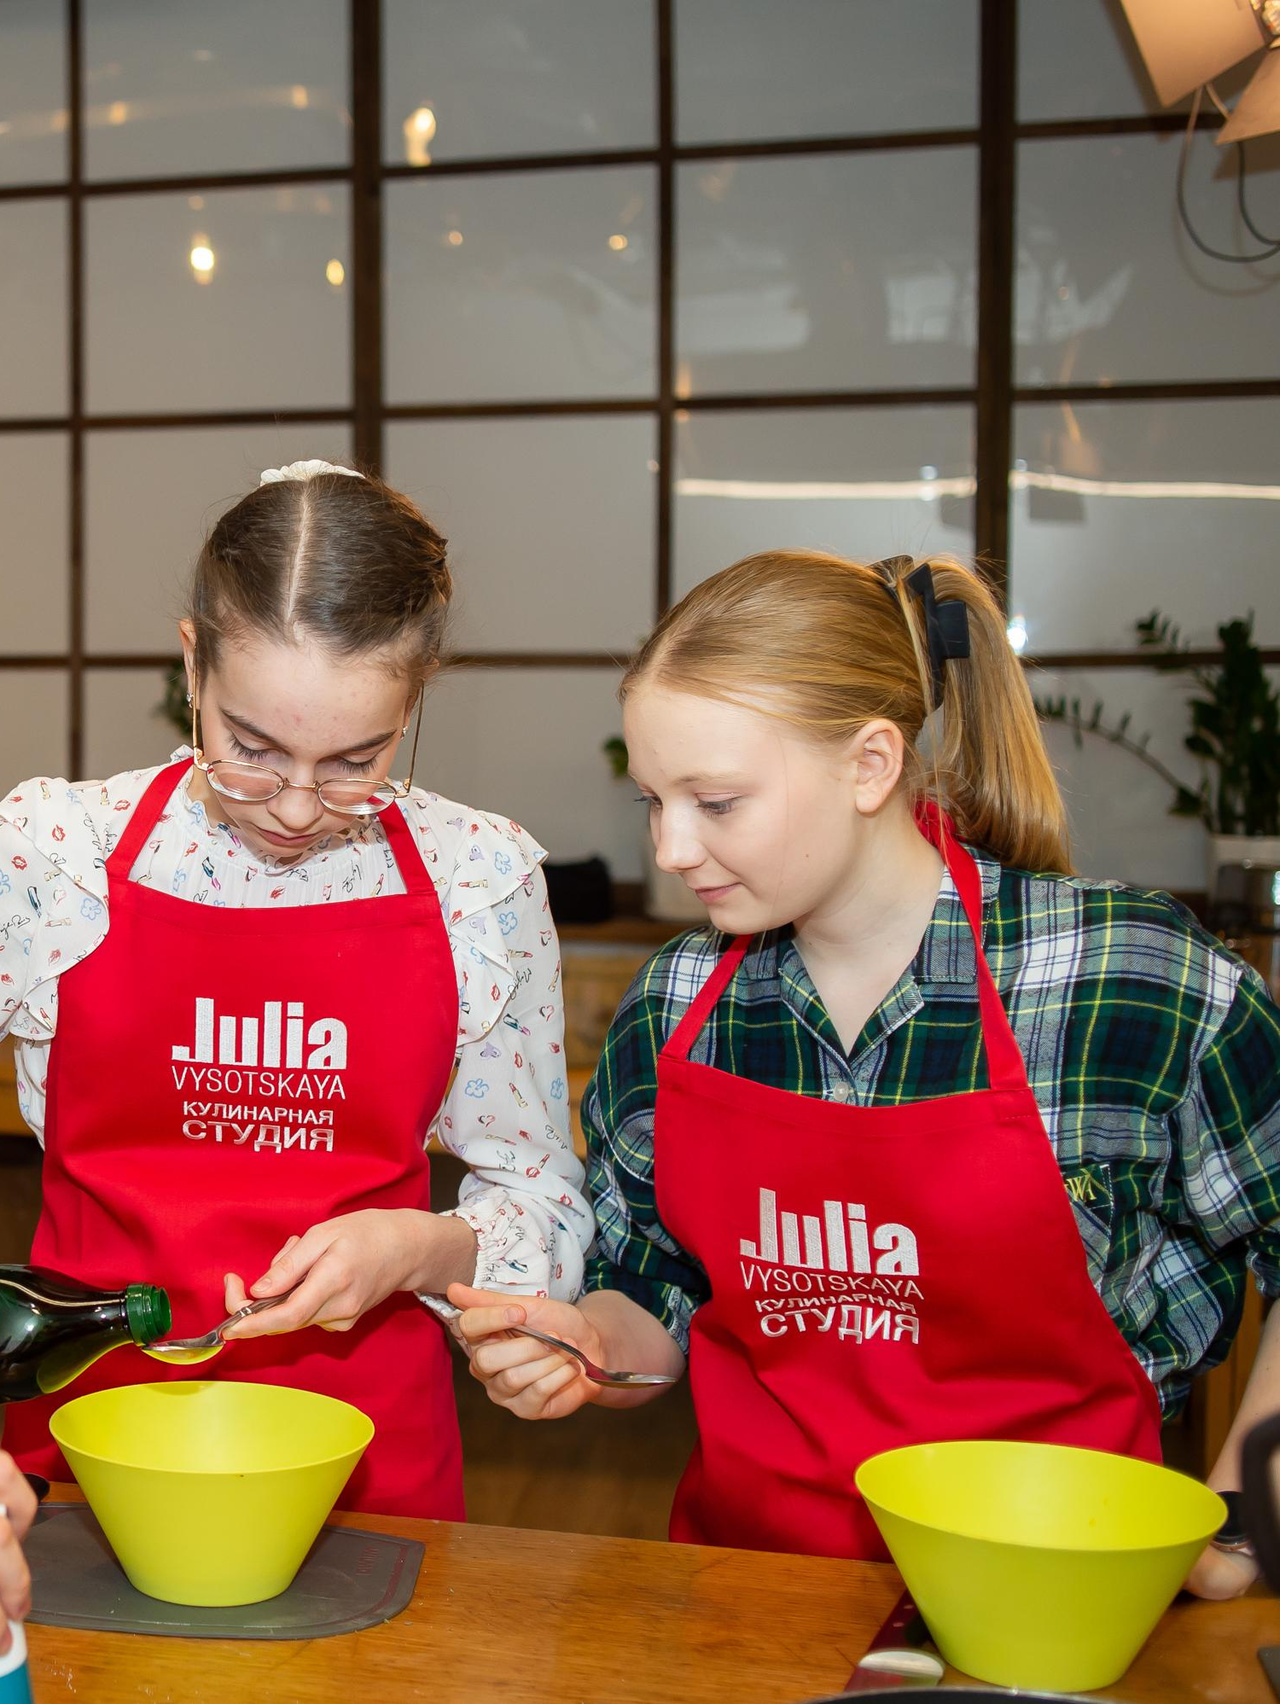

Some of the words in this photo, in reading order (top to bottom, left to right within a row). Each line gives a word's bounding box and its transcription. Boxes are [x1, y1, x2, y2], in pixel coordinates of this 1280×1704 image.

[171, 997, 348, 1070] Julia
[171, 1066, 346, 1100] VYSOTSKAYA
[183, 1101, 334, 1126] КУЛИНАРНАЯ
[182, 1119, 334, 1153] СТУДИЯ
[739, 1187, 920, 1276] Julia
[740, 1261, 925, 1300] VYSOTSKAYA
[755, 1293, 918, 1315] КУЛИНАРНАЯ
[760, 1304, 920, 1345] СТУДИЯ
